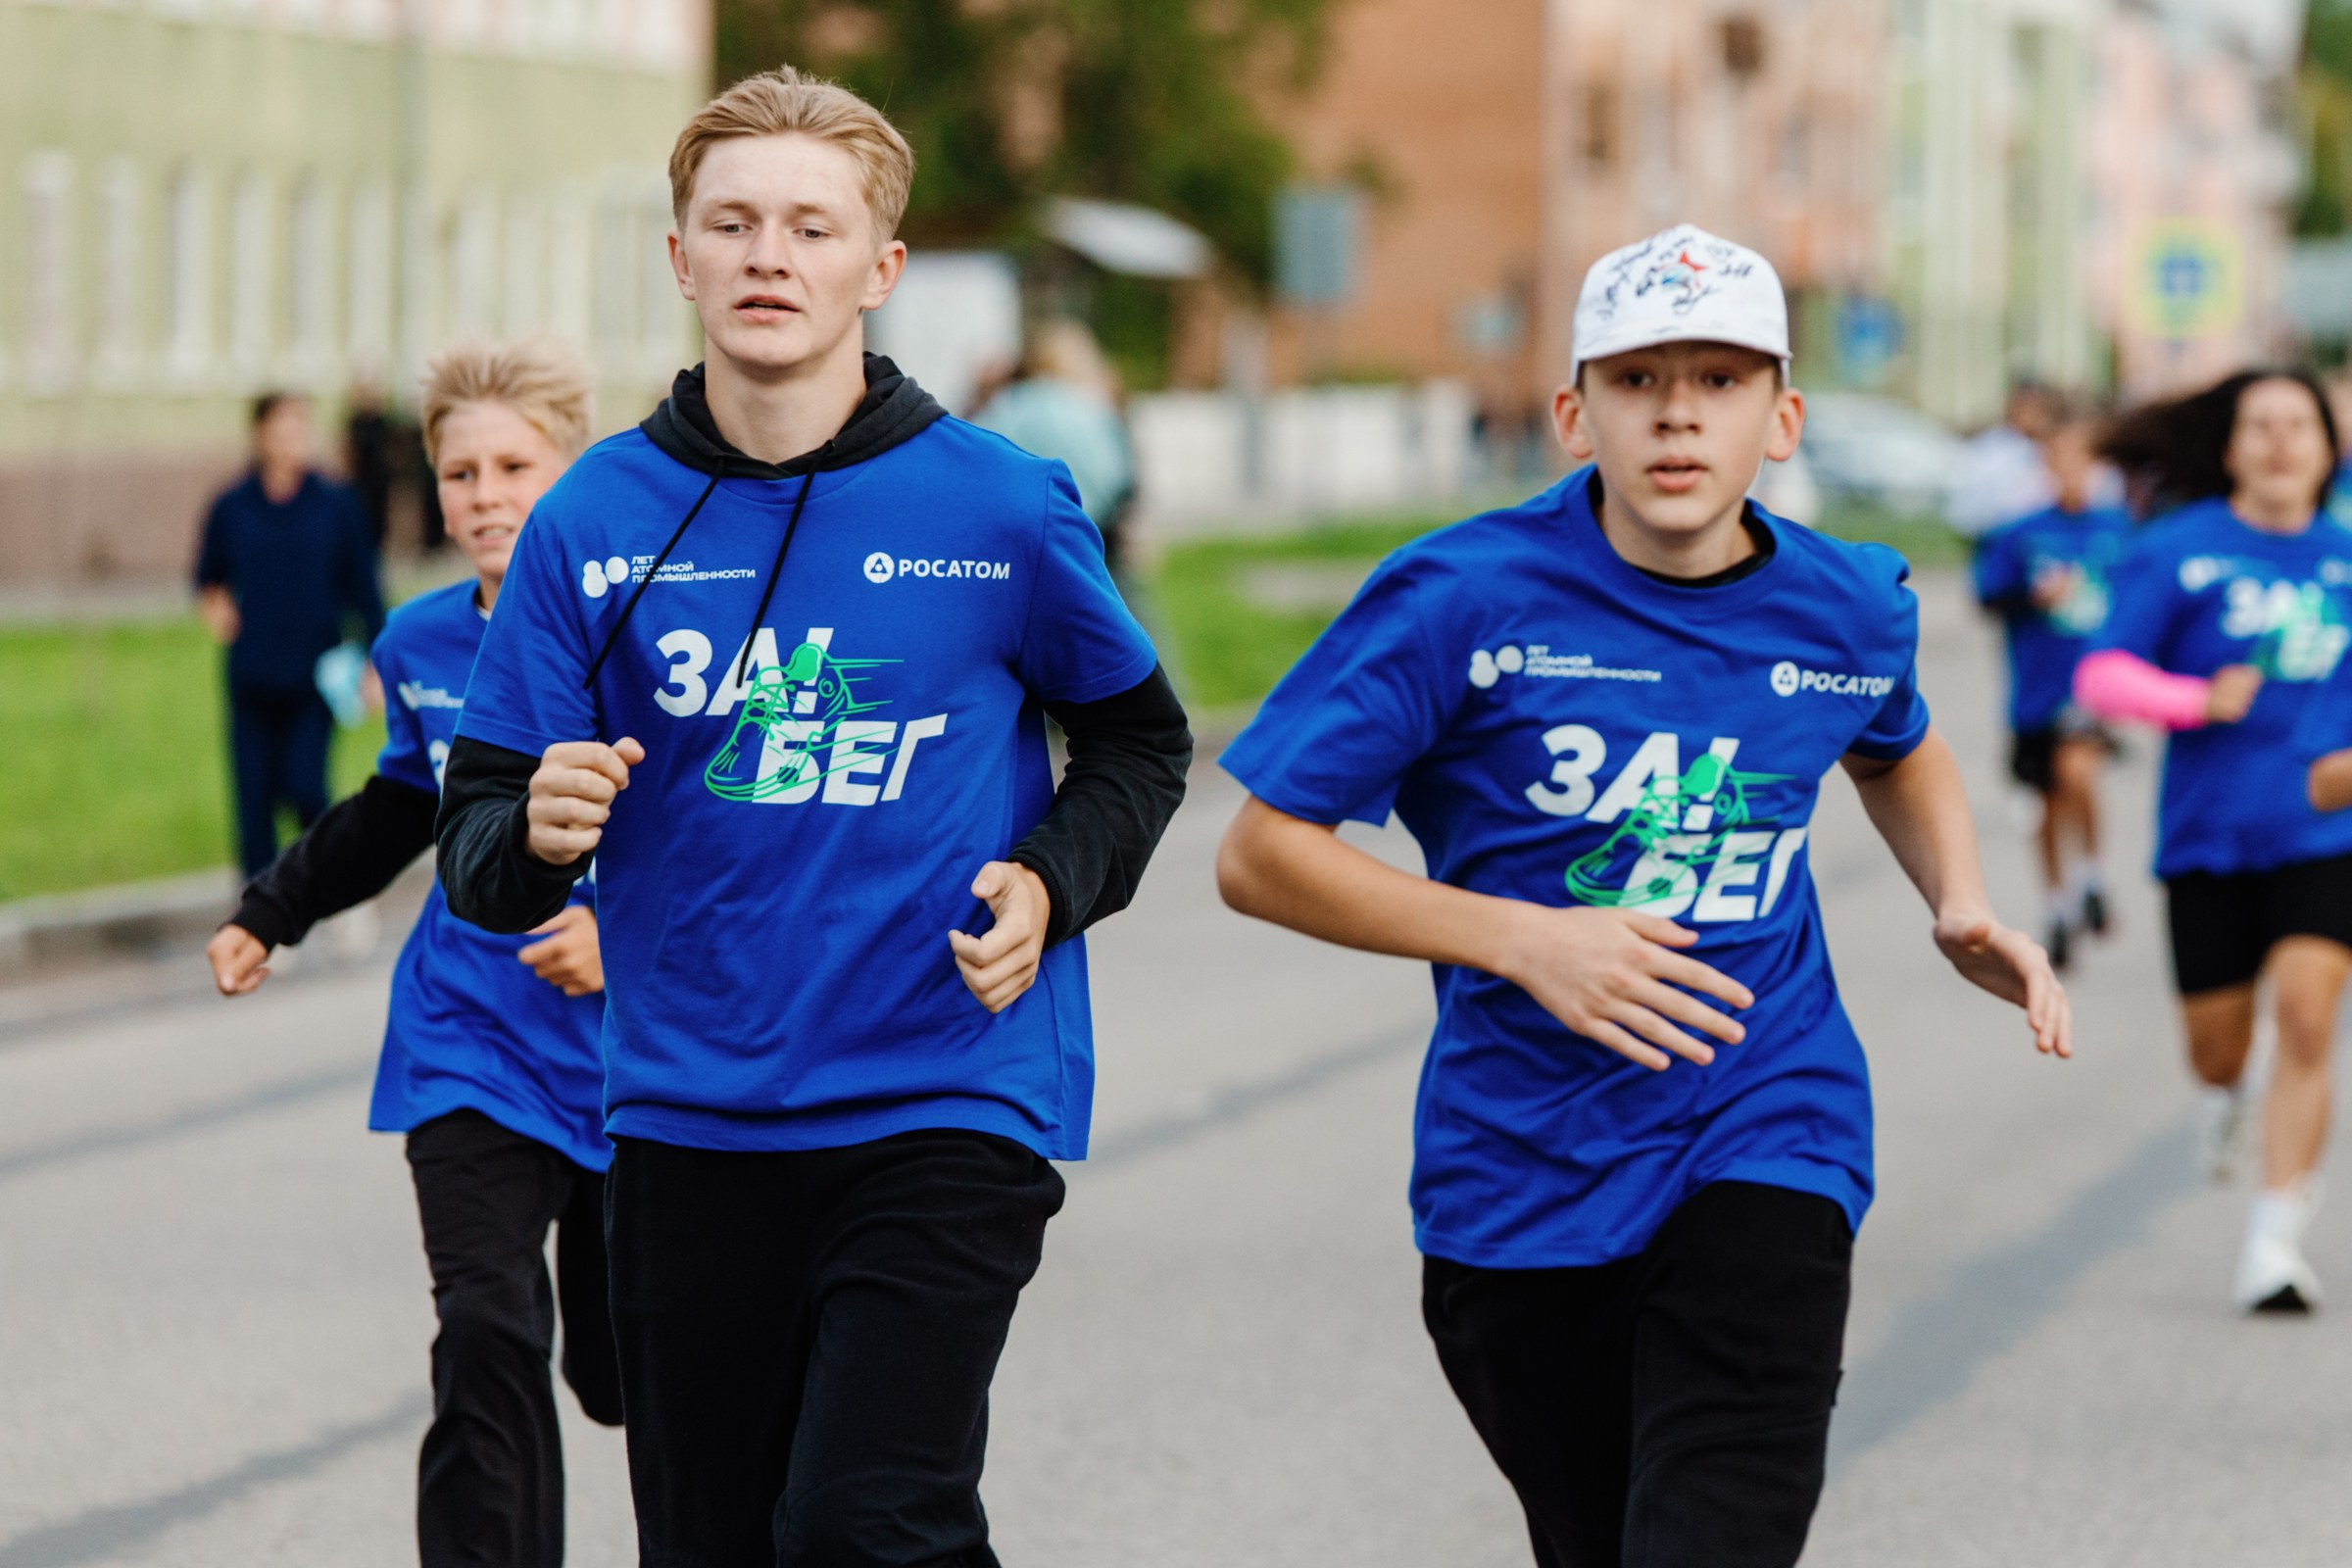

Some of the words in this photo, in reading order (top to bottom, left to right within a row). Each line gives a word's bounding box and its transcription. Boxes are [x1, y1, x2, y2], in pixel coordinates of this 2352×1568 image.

[631, 556, 656, 565] ЛЕТ
[899, 559, 1010, 580] РОСАТОМ
[654, 627, 834, 717] ЗА!
[751, 713, 948, 806] БЕГ
[1525, 723, 1740, 831] ЗА!
[1617, 826, 1808, 922] БЕГ
